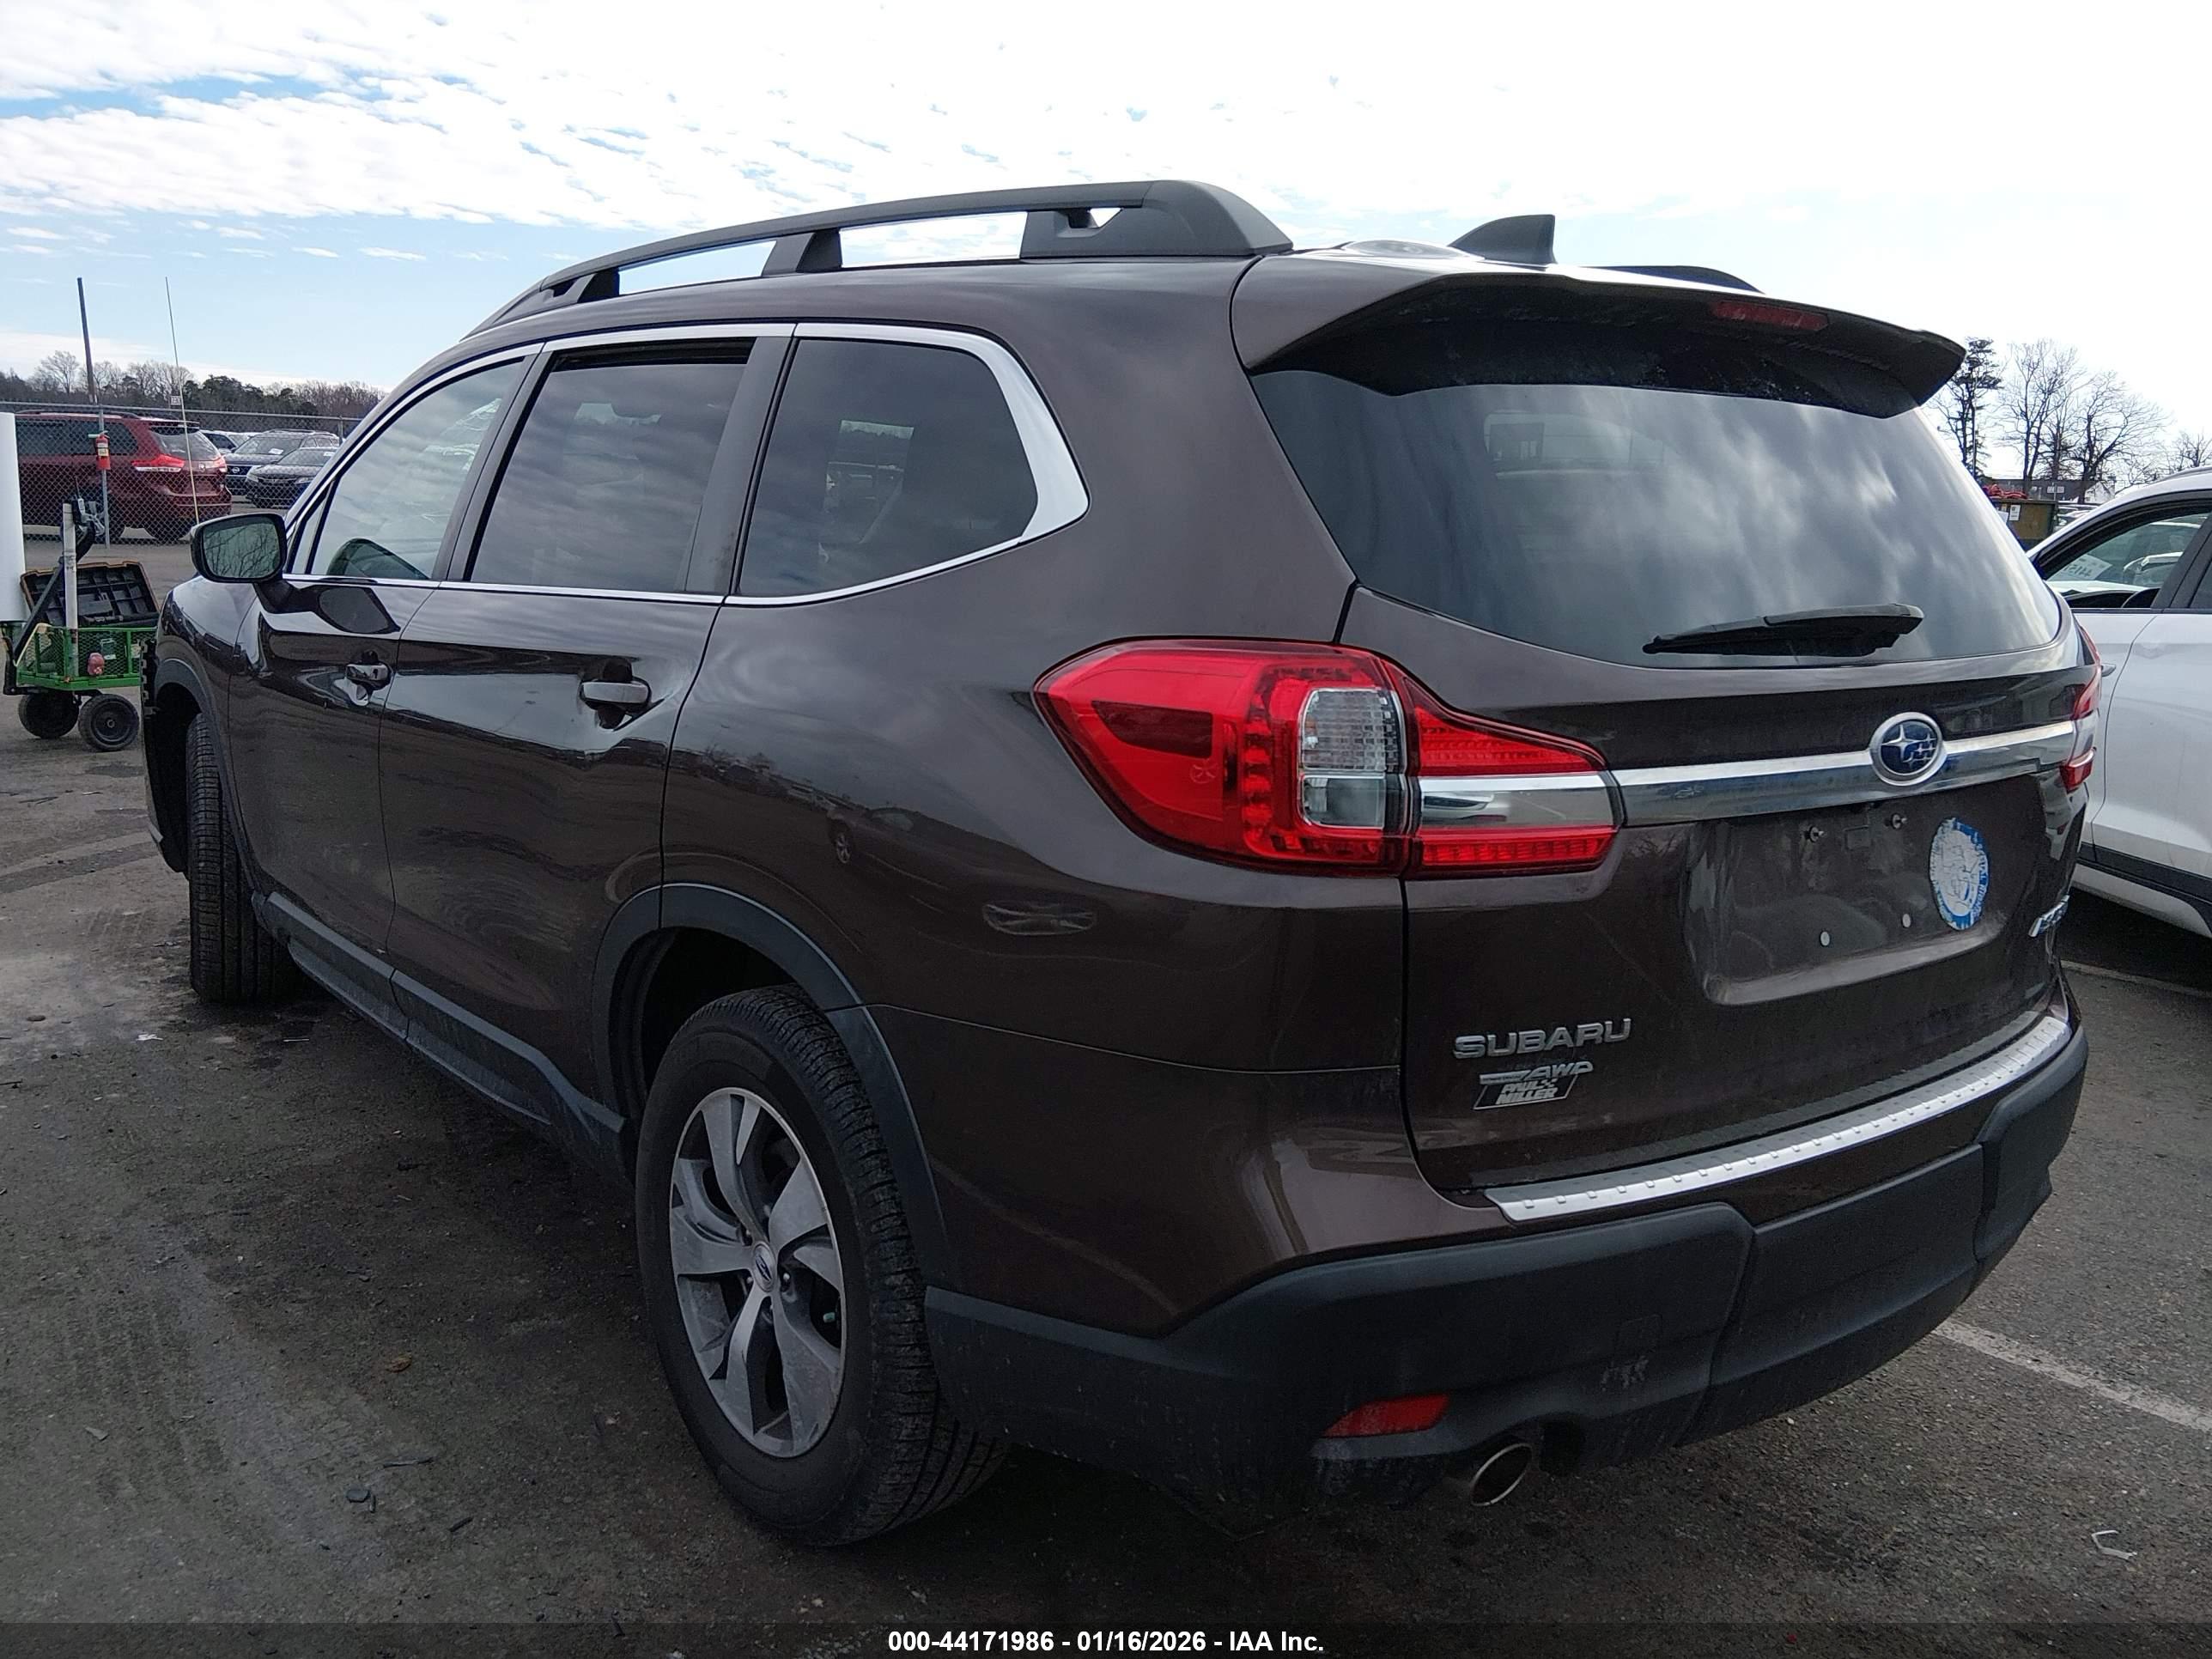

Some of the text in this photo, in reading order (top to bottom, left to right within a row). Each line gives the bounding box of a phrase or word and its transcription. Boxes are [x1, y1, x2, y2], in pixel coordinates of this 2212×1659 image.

[1453, 1018, 1632, 1059] SUBARU
[1525, 1061, 1593, 1080] AWD
[1501, 1080, 1542, 1093] PAUL
[1495, 1088, 1558, 1105] MILLER
